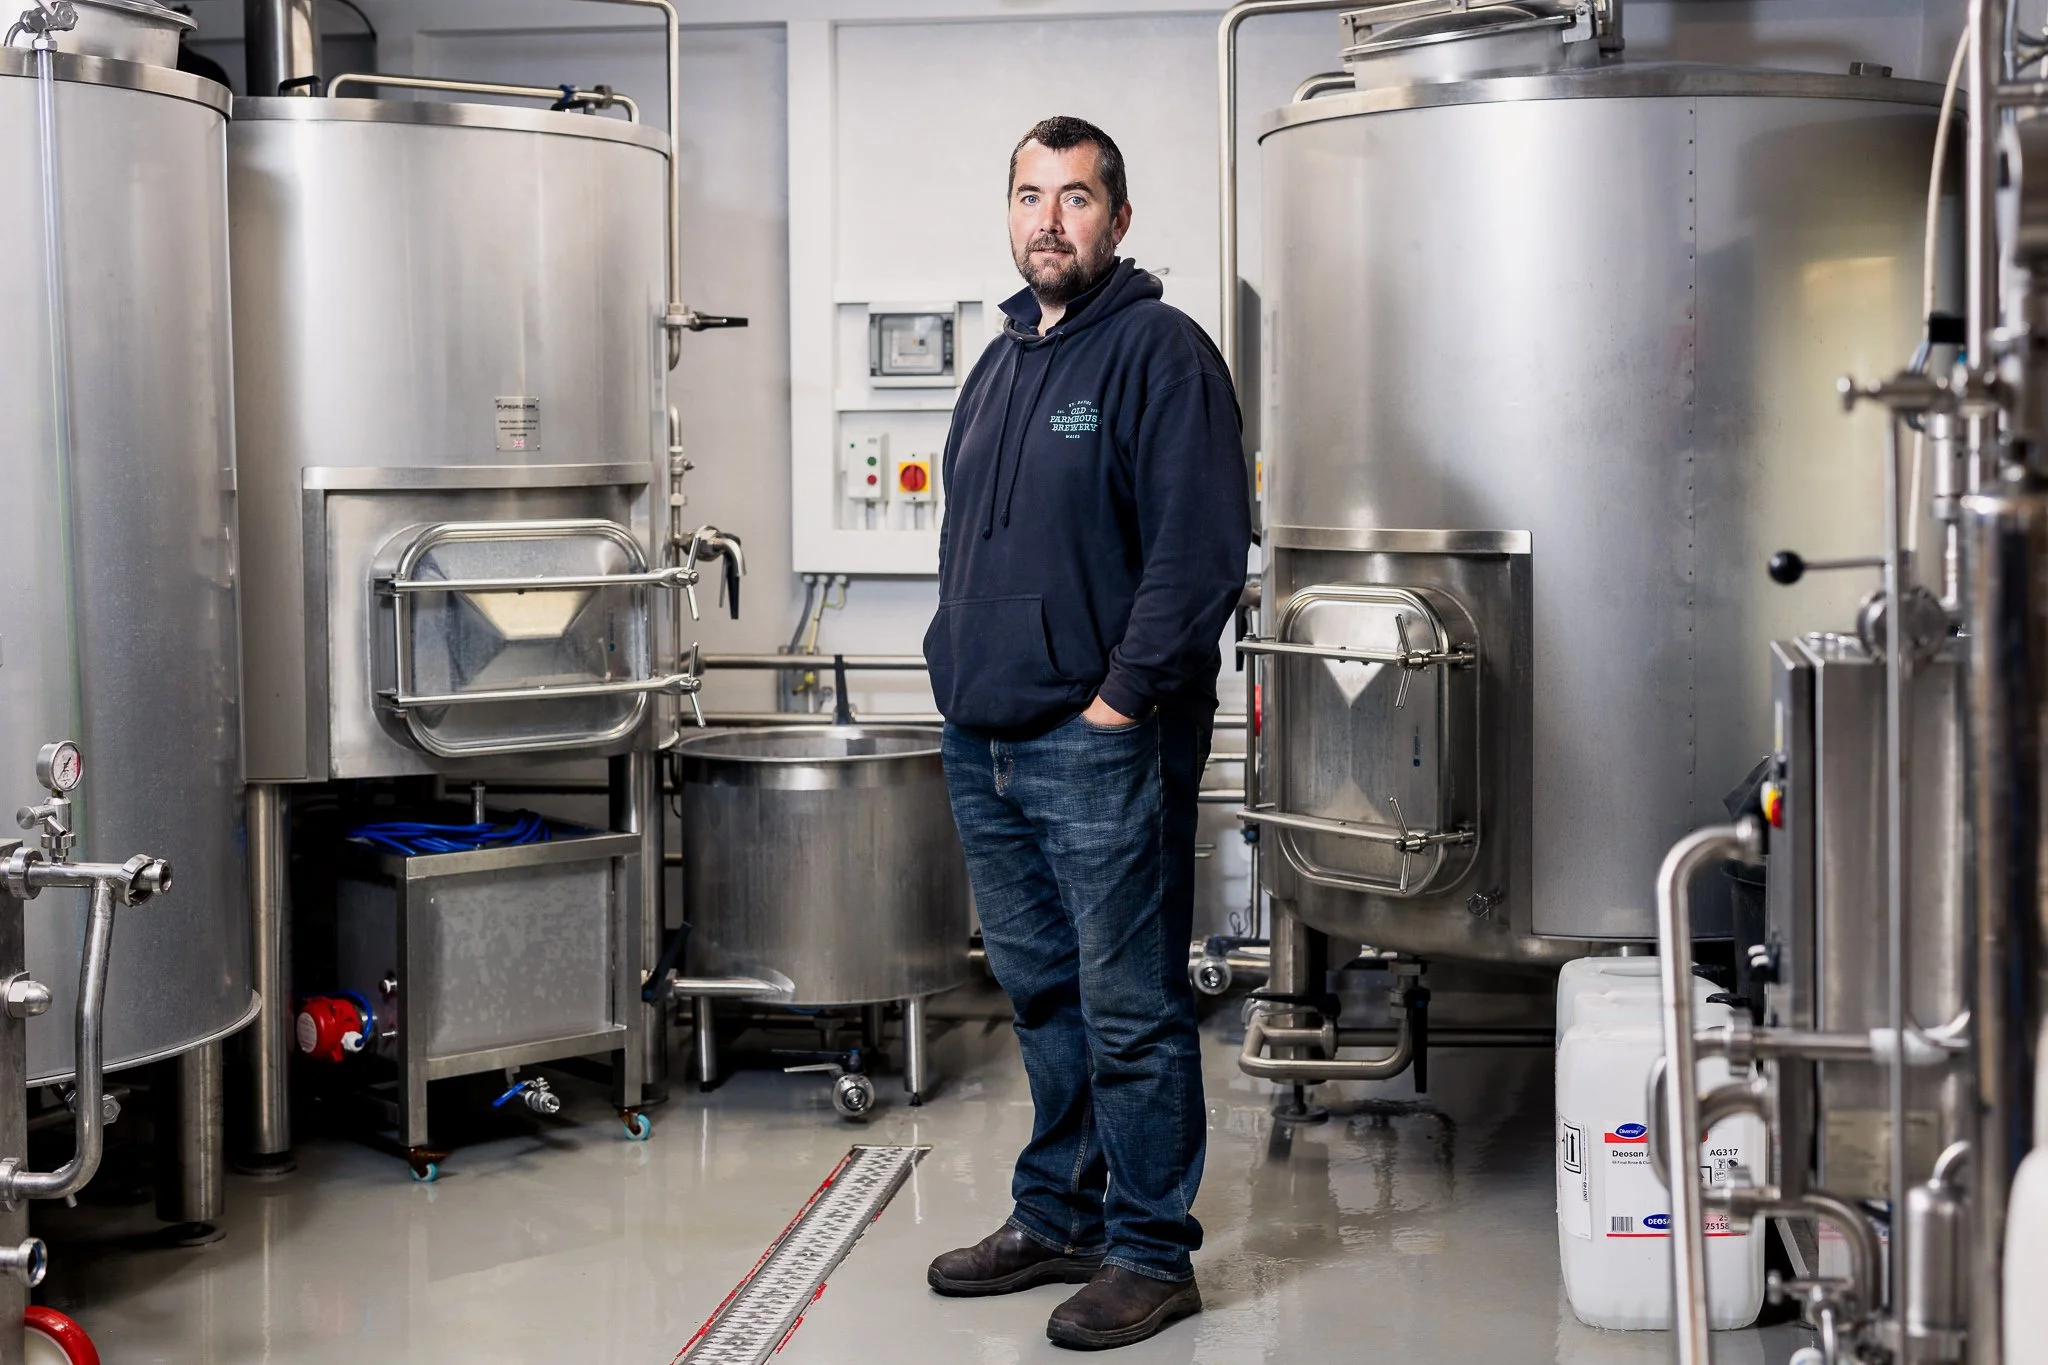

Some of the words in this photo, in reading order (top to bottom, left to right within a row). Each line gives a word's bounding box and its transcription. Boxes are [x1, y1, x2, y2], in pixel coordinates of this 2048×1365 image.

[1070, 407, 1087, 415] OLD
[1051, 424, 1098, 432] BREWERY
[1709, 1148, 1739, 1157] AG317
